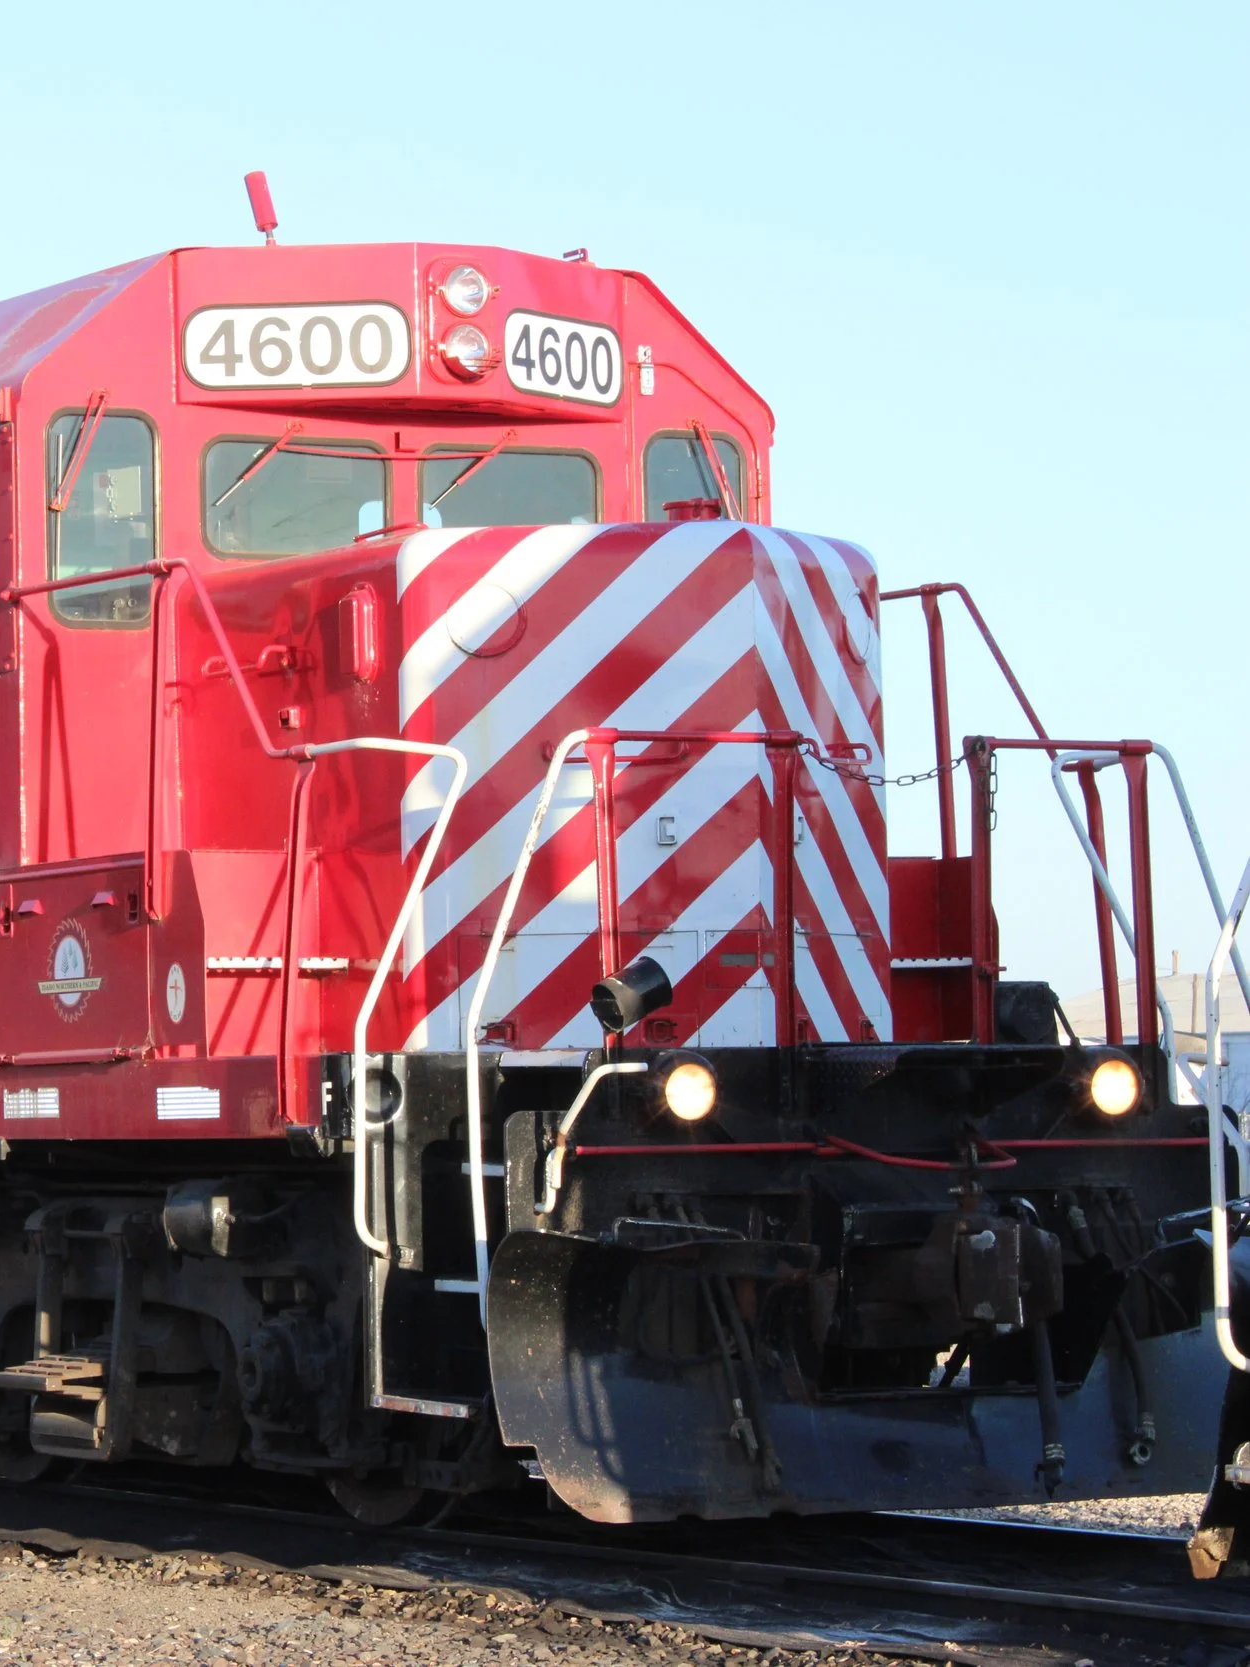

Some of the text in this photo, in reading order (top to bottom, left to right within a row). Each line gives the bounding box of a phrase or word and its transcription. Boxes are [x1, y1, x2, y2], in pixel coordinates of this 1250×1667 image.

[199, 314, 393, 378] 4600
[512, 323, 614, 395] 4600
[321, 1081, 333, 1116] F
